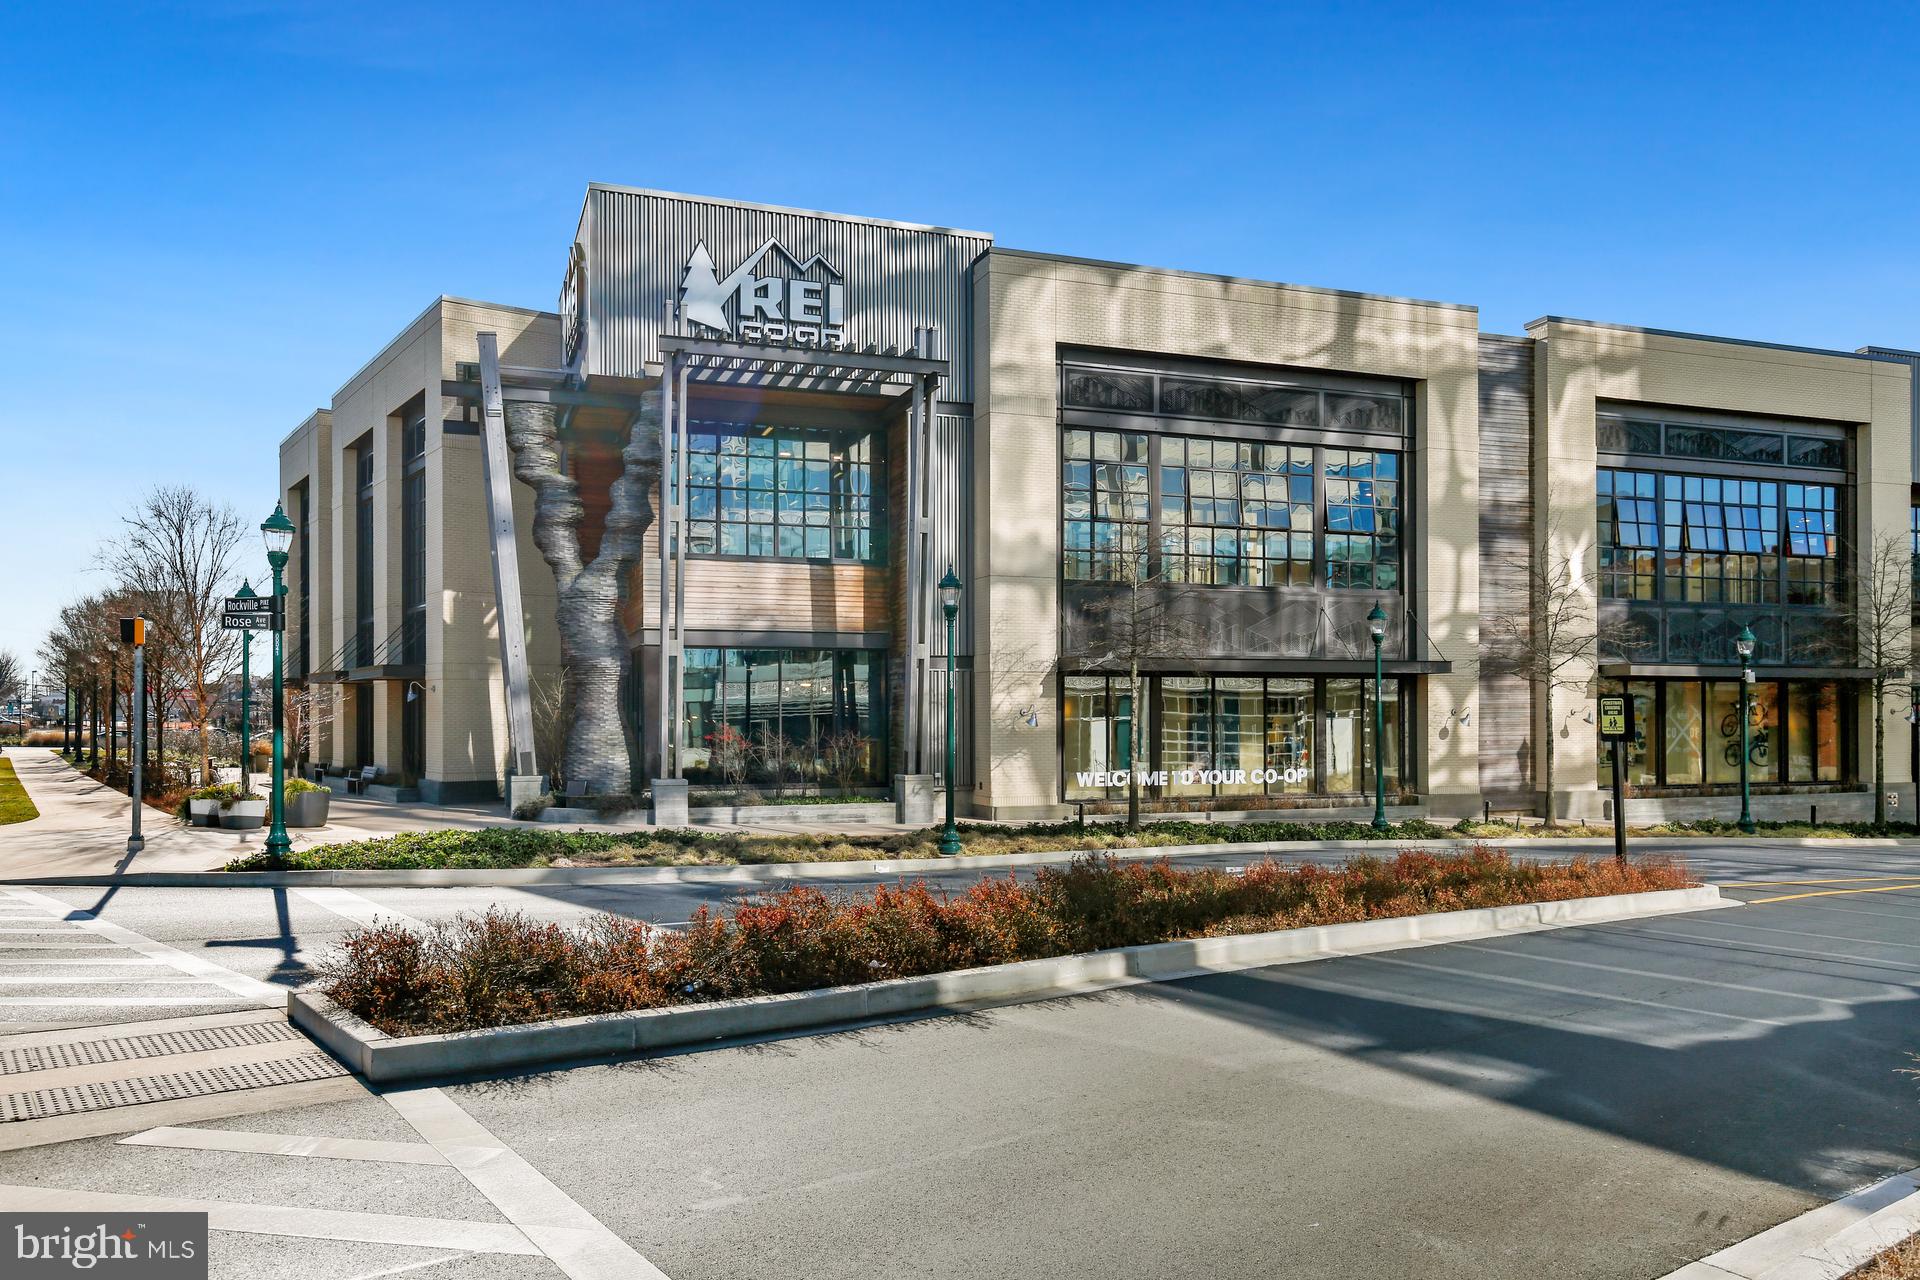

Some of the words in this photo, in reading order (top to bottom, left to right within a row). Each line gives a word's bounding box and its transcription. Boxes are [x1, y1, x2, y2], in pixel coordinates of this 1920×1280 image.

[740, 275, 844, 325] REI
[228, 600, 258, 610] Rockville
[225, 617, 252, 627] Rose
[1172, 769, 1195, 786] TO
[1199, 769, 1247, 785] YOUR
[1251, 768, 1308, 784] CO-OP
